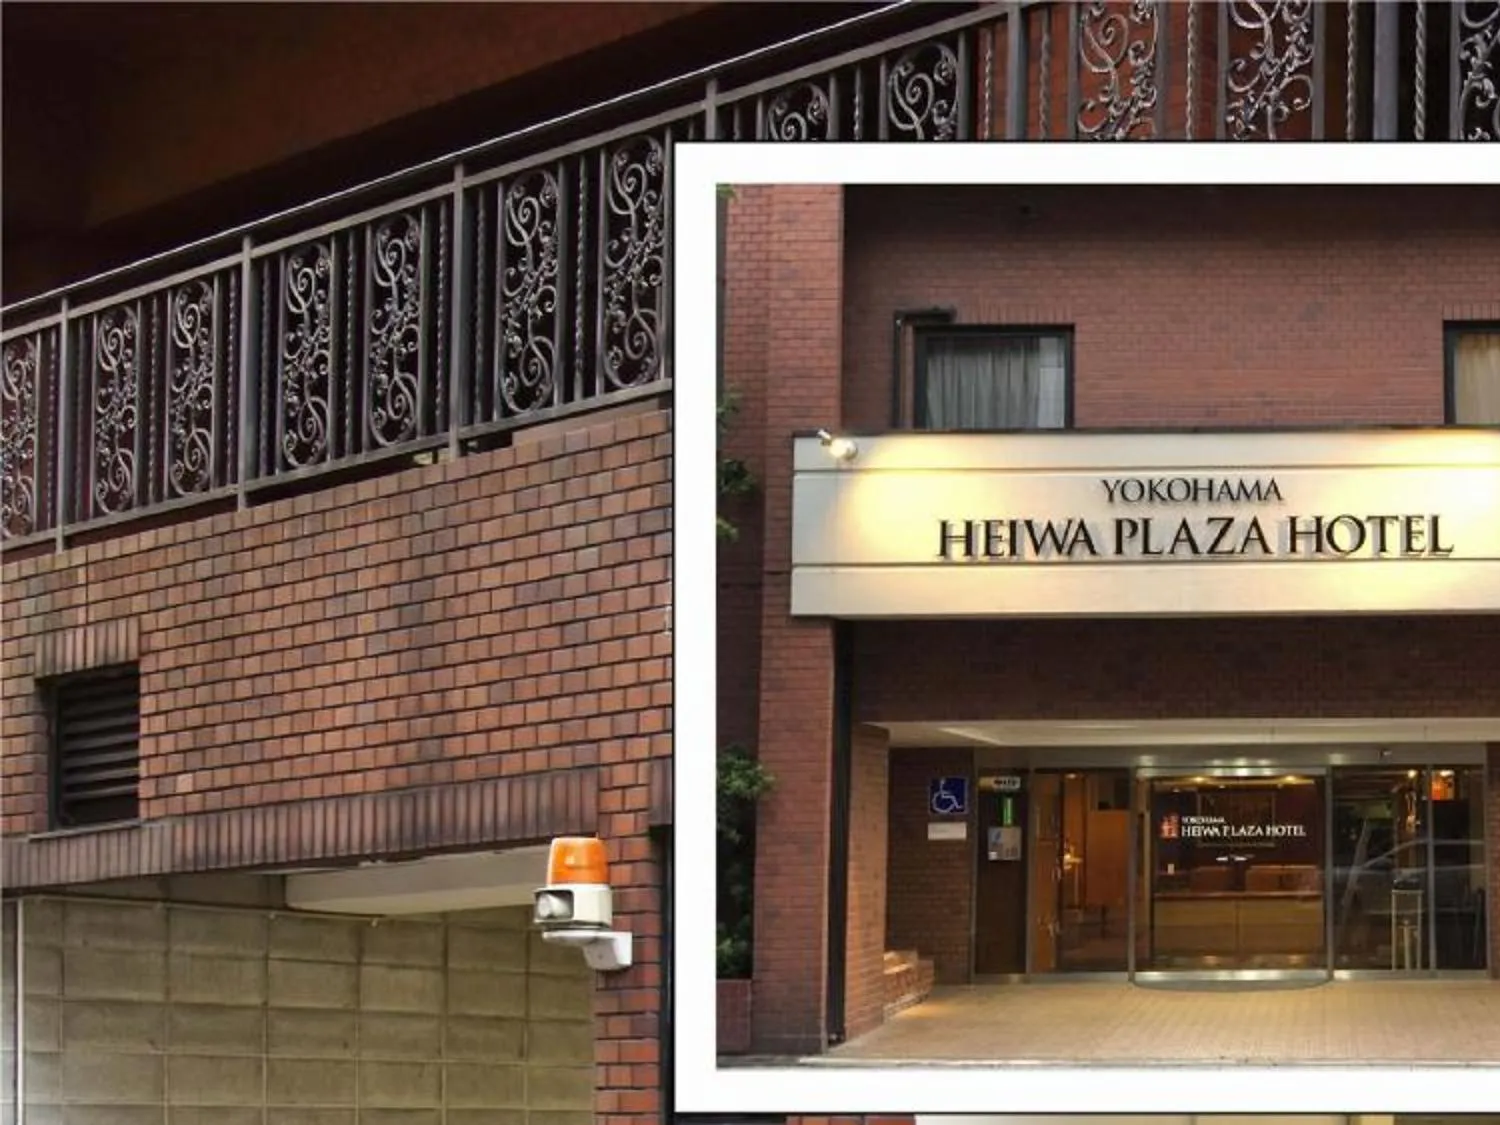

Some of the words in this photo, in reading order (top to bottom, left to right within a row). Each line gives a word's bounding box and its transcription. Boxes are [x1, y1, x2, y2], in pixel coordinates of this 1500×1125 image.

[1102, 476, 1285, 503] YOKOHAMA
[937, 518, 1099, 557] HEIWA
[1113, 515, 1274, 556] PLAZA
[1287, 513, 1455, 555] HOTEL
[1181, 824, 1221, 838] HEIWA
[1222, 824, 1265, 838] PLAZA
[1265, 824, 1307, 838] HOTEL
